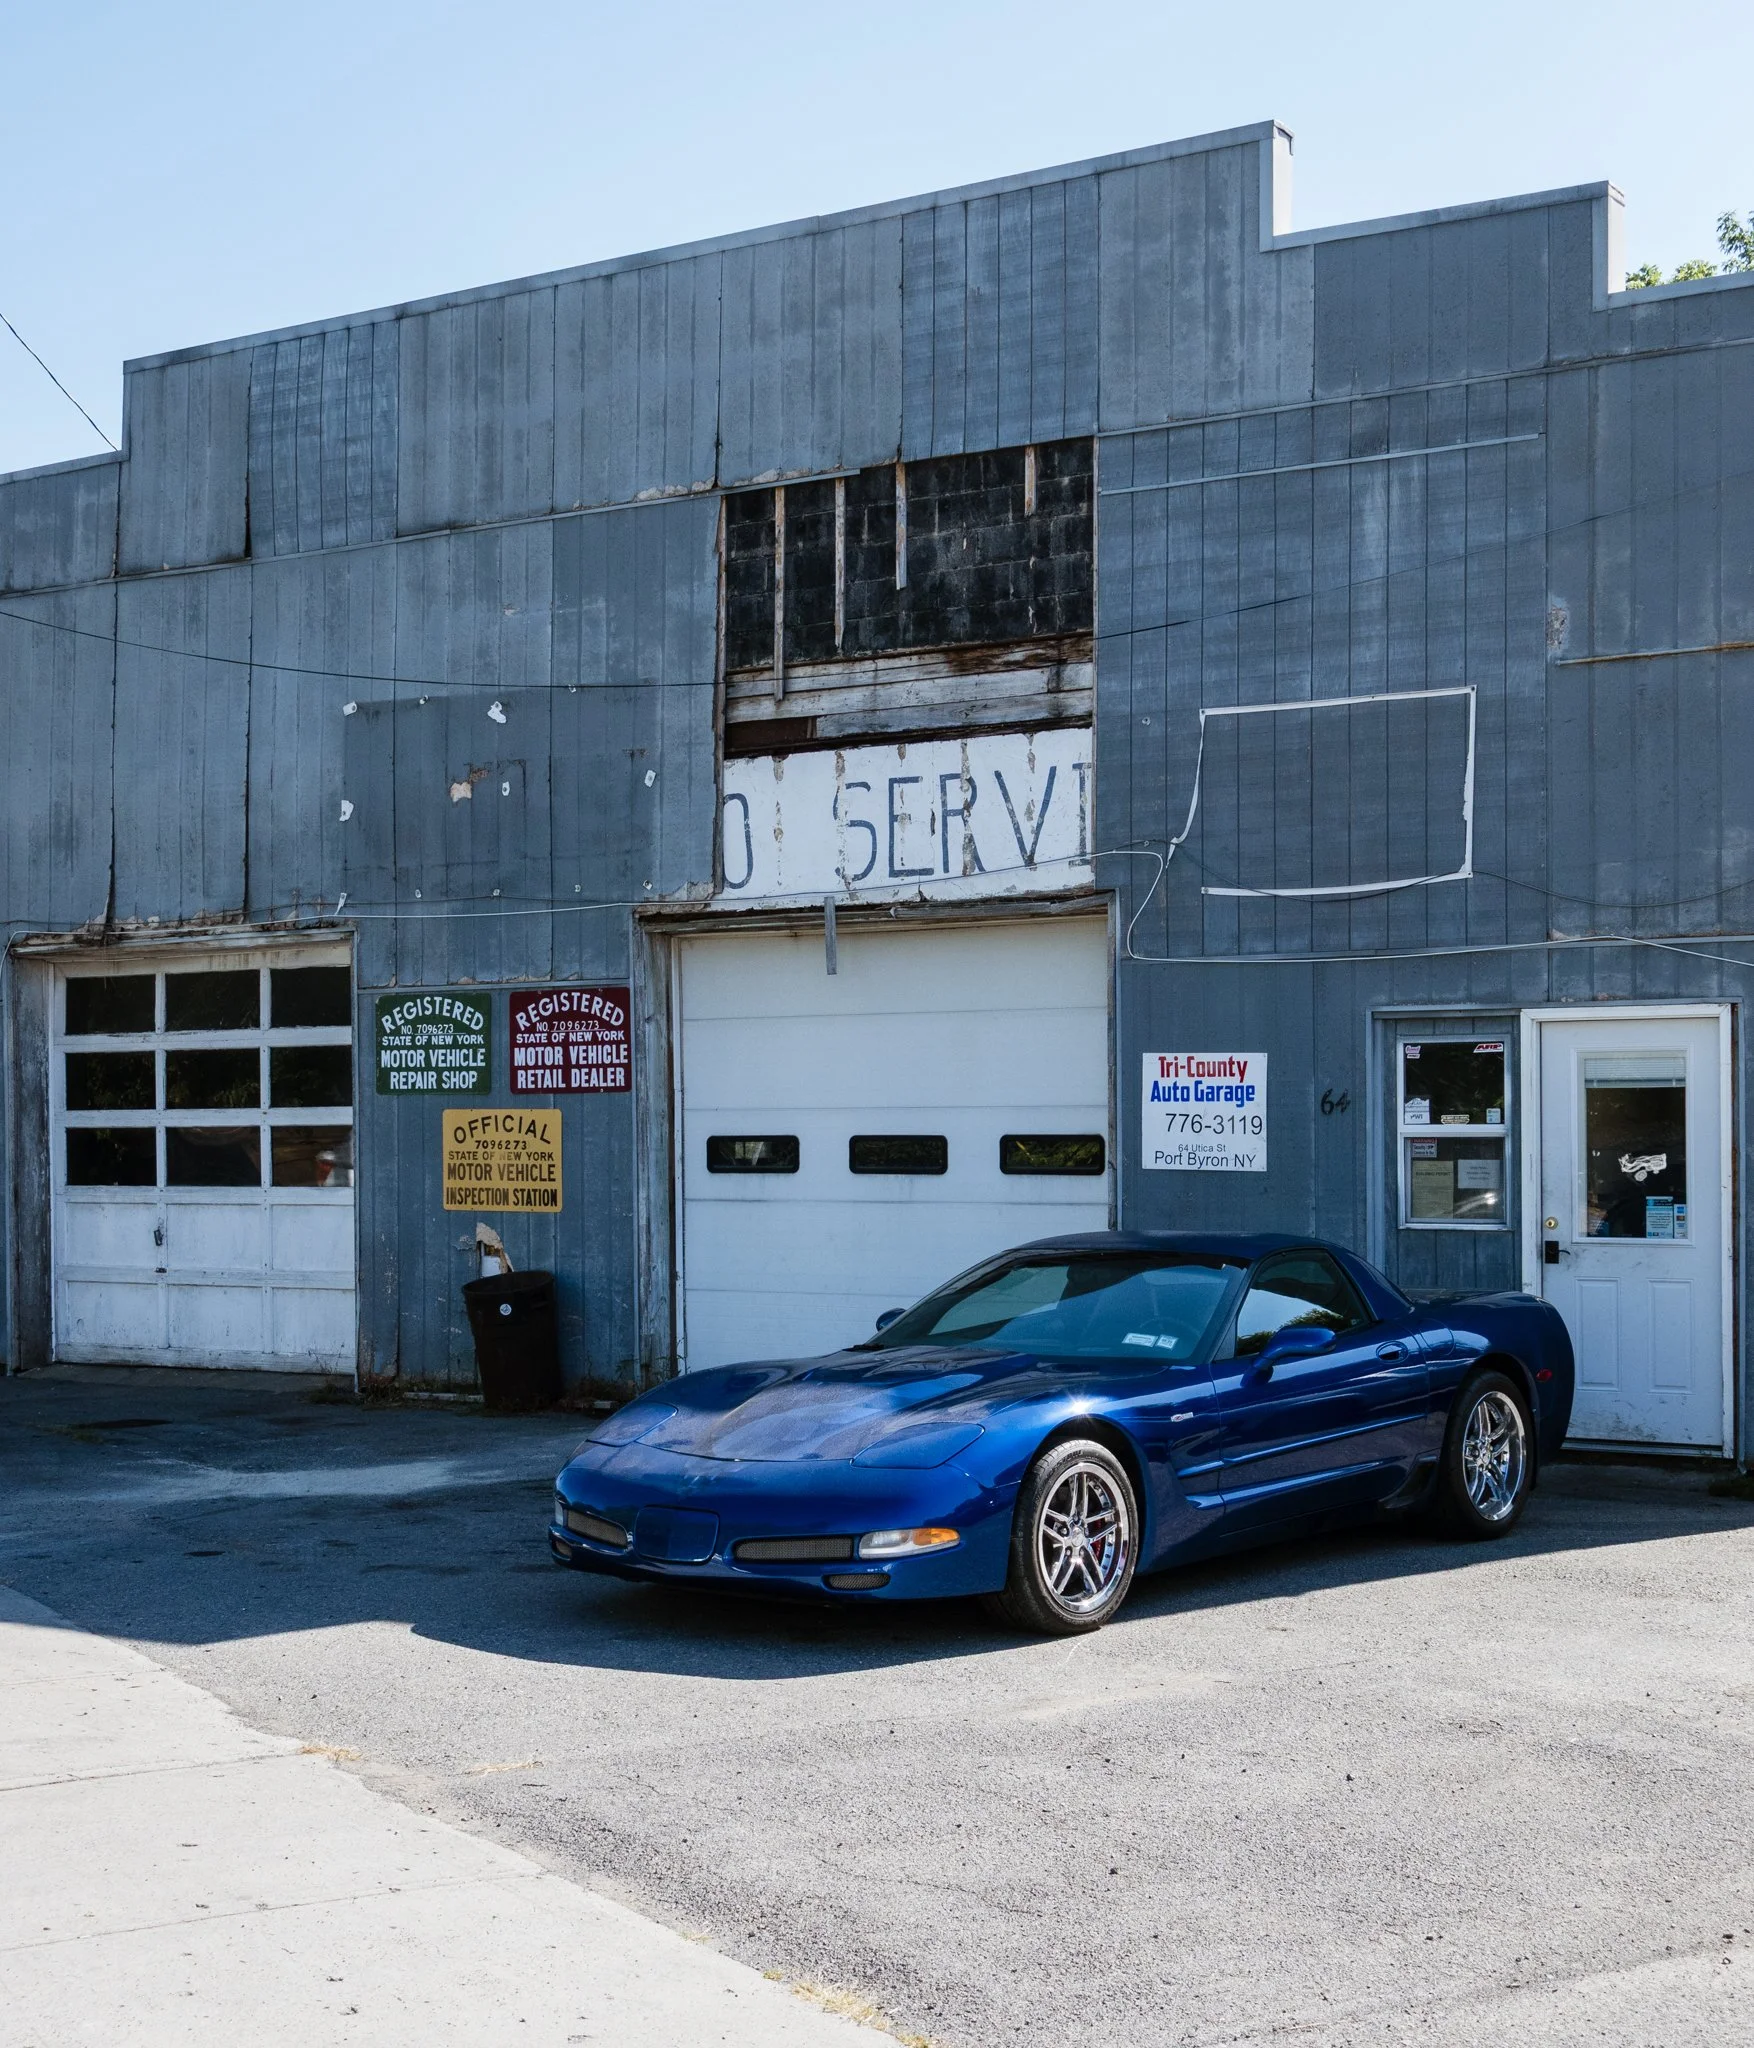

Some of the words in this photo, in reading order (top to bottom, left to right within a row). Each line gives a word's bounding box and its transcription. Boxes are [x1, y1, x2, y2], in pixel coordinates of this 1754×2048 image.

[381, 996, 484, 1033] REGISTERED
[516, 992, 624, 1030] REGISTERED
[402, 1026, 413, 1034] NO.
[417, 1024, 454, 1034] 7096273
[536, 1022, 548, 1032] NO.
[552, 1021, 599, 1030] 7096273
[382, 1036, 412, 1046] STATE
[416, 1036, 428, 1045] OF
[432, 1036, 452, 1045] NEW
[458, 1034, 484, 1044] YORK
[516, 1033, 548, 1043] STATE
[552, 1032, 566, 1043] OF
[569, 1032, 592, 1042] NEW
[596, 1031, 624, 1041] YORK
[381, 1050, 425, 1068] MOTOR
[429, 1049, 486, 1067] VEHICLE
[514, 1047, 563, 1066] MOTOR
[569, 1045, 628, 1065] VEHICLE
[518, 1070, 566, 1088] RETAIL
[571, 1068, 625, 1088] DEALER
[1159, 1055, 1248, 1083] Tri-County
[390, 1072, 436, 1090] REPAIR
[442, 1071, 477, 1088] SHOP
[1151, 1080, 1190, 1102] Auto
[1194, 1080, 1255, 1108] Garage
[454, 1114, 551, 1144] OFFICIAL
[1165, 1113, 1262, 1135] 776-3119
[475, 1140, 527, 1150] 7096273
[1192, 1144, 1213, 1152] Utica
[448, 1151, 478, 1160] STATE
[482, 1151, 496, 1161] OF
[500, 1151, 522, 1161] NEW
[526, 1152, 554, 1162] YORK
[1155, 1151, 1182, 1165] Port
[1188, 1152, 1228, 1169] Byron
[1234, 1154, 1256, 1167] NY
[448, 1163, 492, 1181] MOTOR
[499, 1164, 556, 1182] VEHICLE
[446, 1187, 509, 1205] INSPECTION
[513, 1188, 557, 1207] STATION
